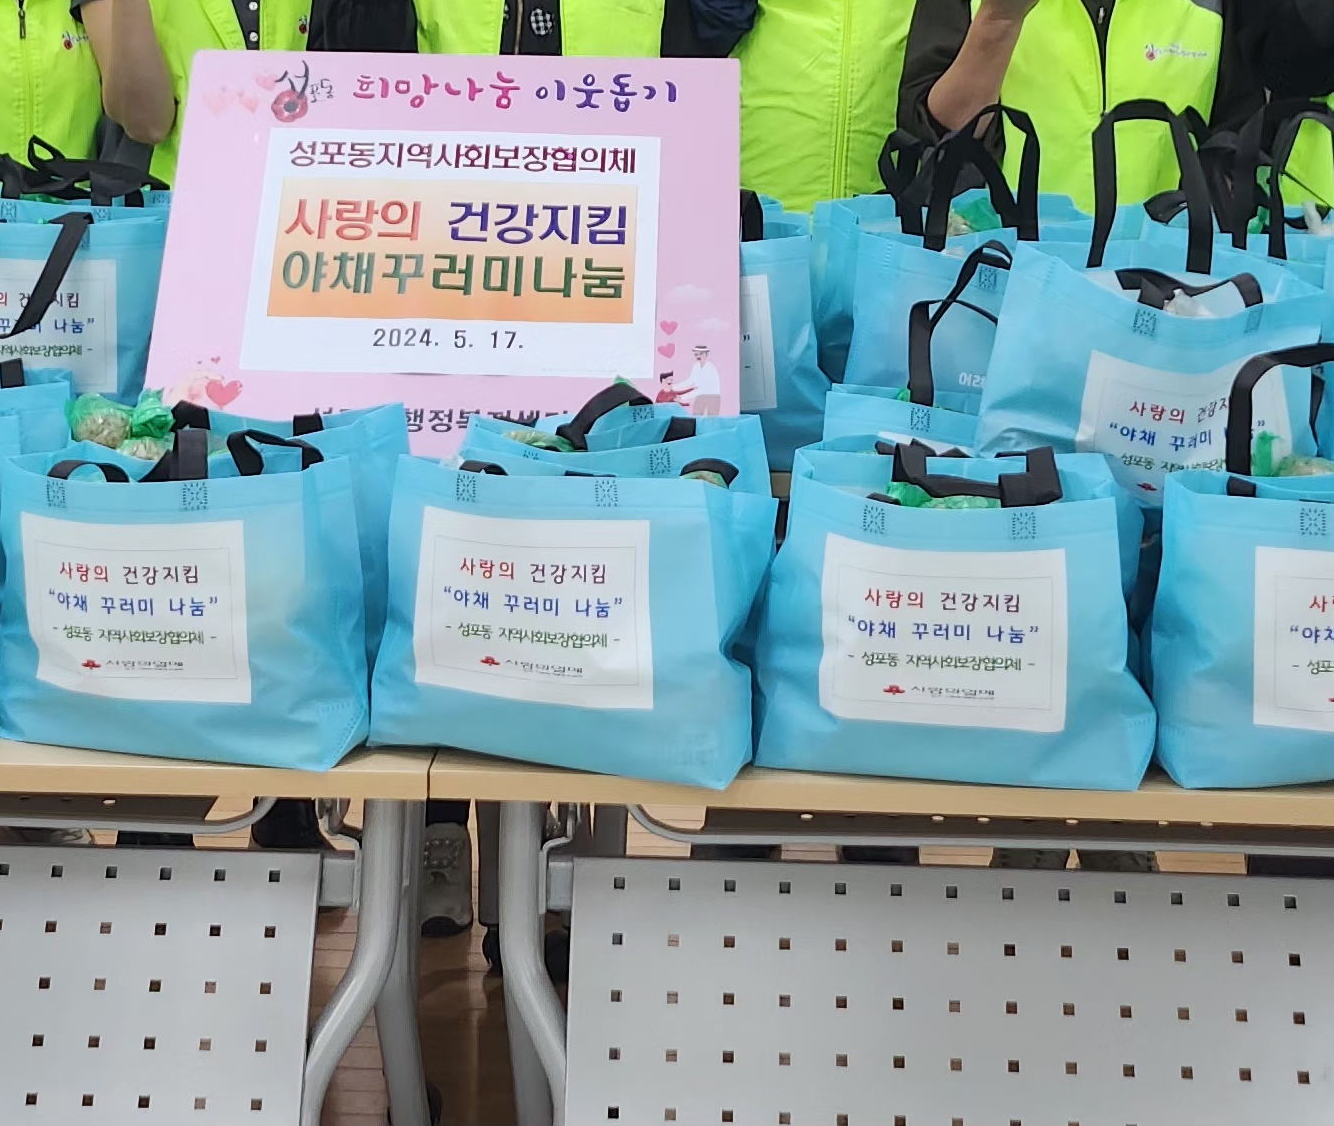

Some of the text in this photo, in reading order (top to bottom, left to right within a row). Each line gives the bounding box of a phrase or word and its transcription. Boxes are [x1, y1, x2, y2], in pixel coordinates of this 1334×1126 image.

[288, 139, 637, 175] 성포동지역사회보장협의체
[283, 197, 627, 246] 사랑의 건강지킴
[282, 250, 626, 299] 야채꾸러미나눔
[372, 327, 524, 350] 2024. 5. 17.
[1128, 396, 1230, 425] 사랑의 건강지
[58, 560, 200, 586] 사랑의 건강지킴
[459, 557, 607, 585] 사랑의 건강지킴
[100, 596, 155, 617] 꾸러미
[503, 593, 560, 617] 꾸러미
[864, 587, 1021, 614] 사랑의 건강지킴
[911, 621, 971, 642] 꾸러미
